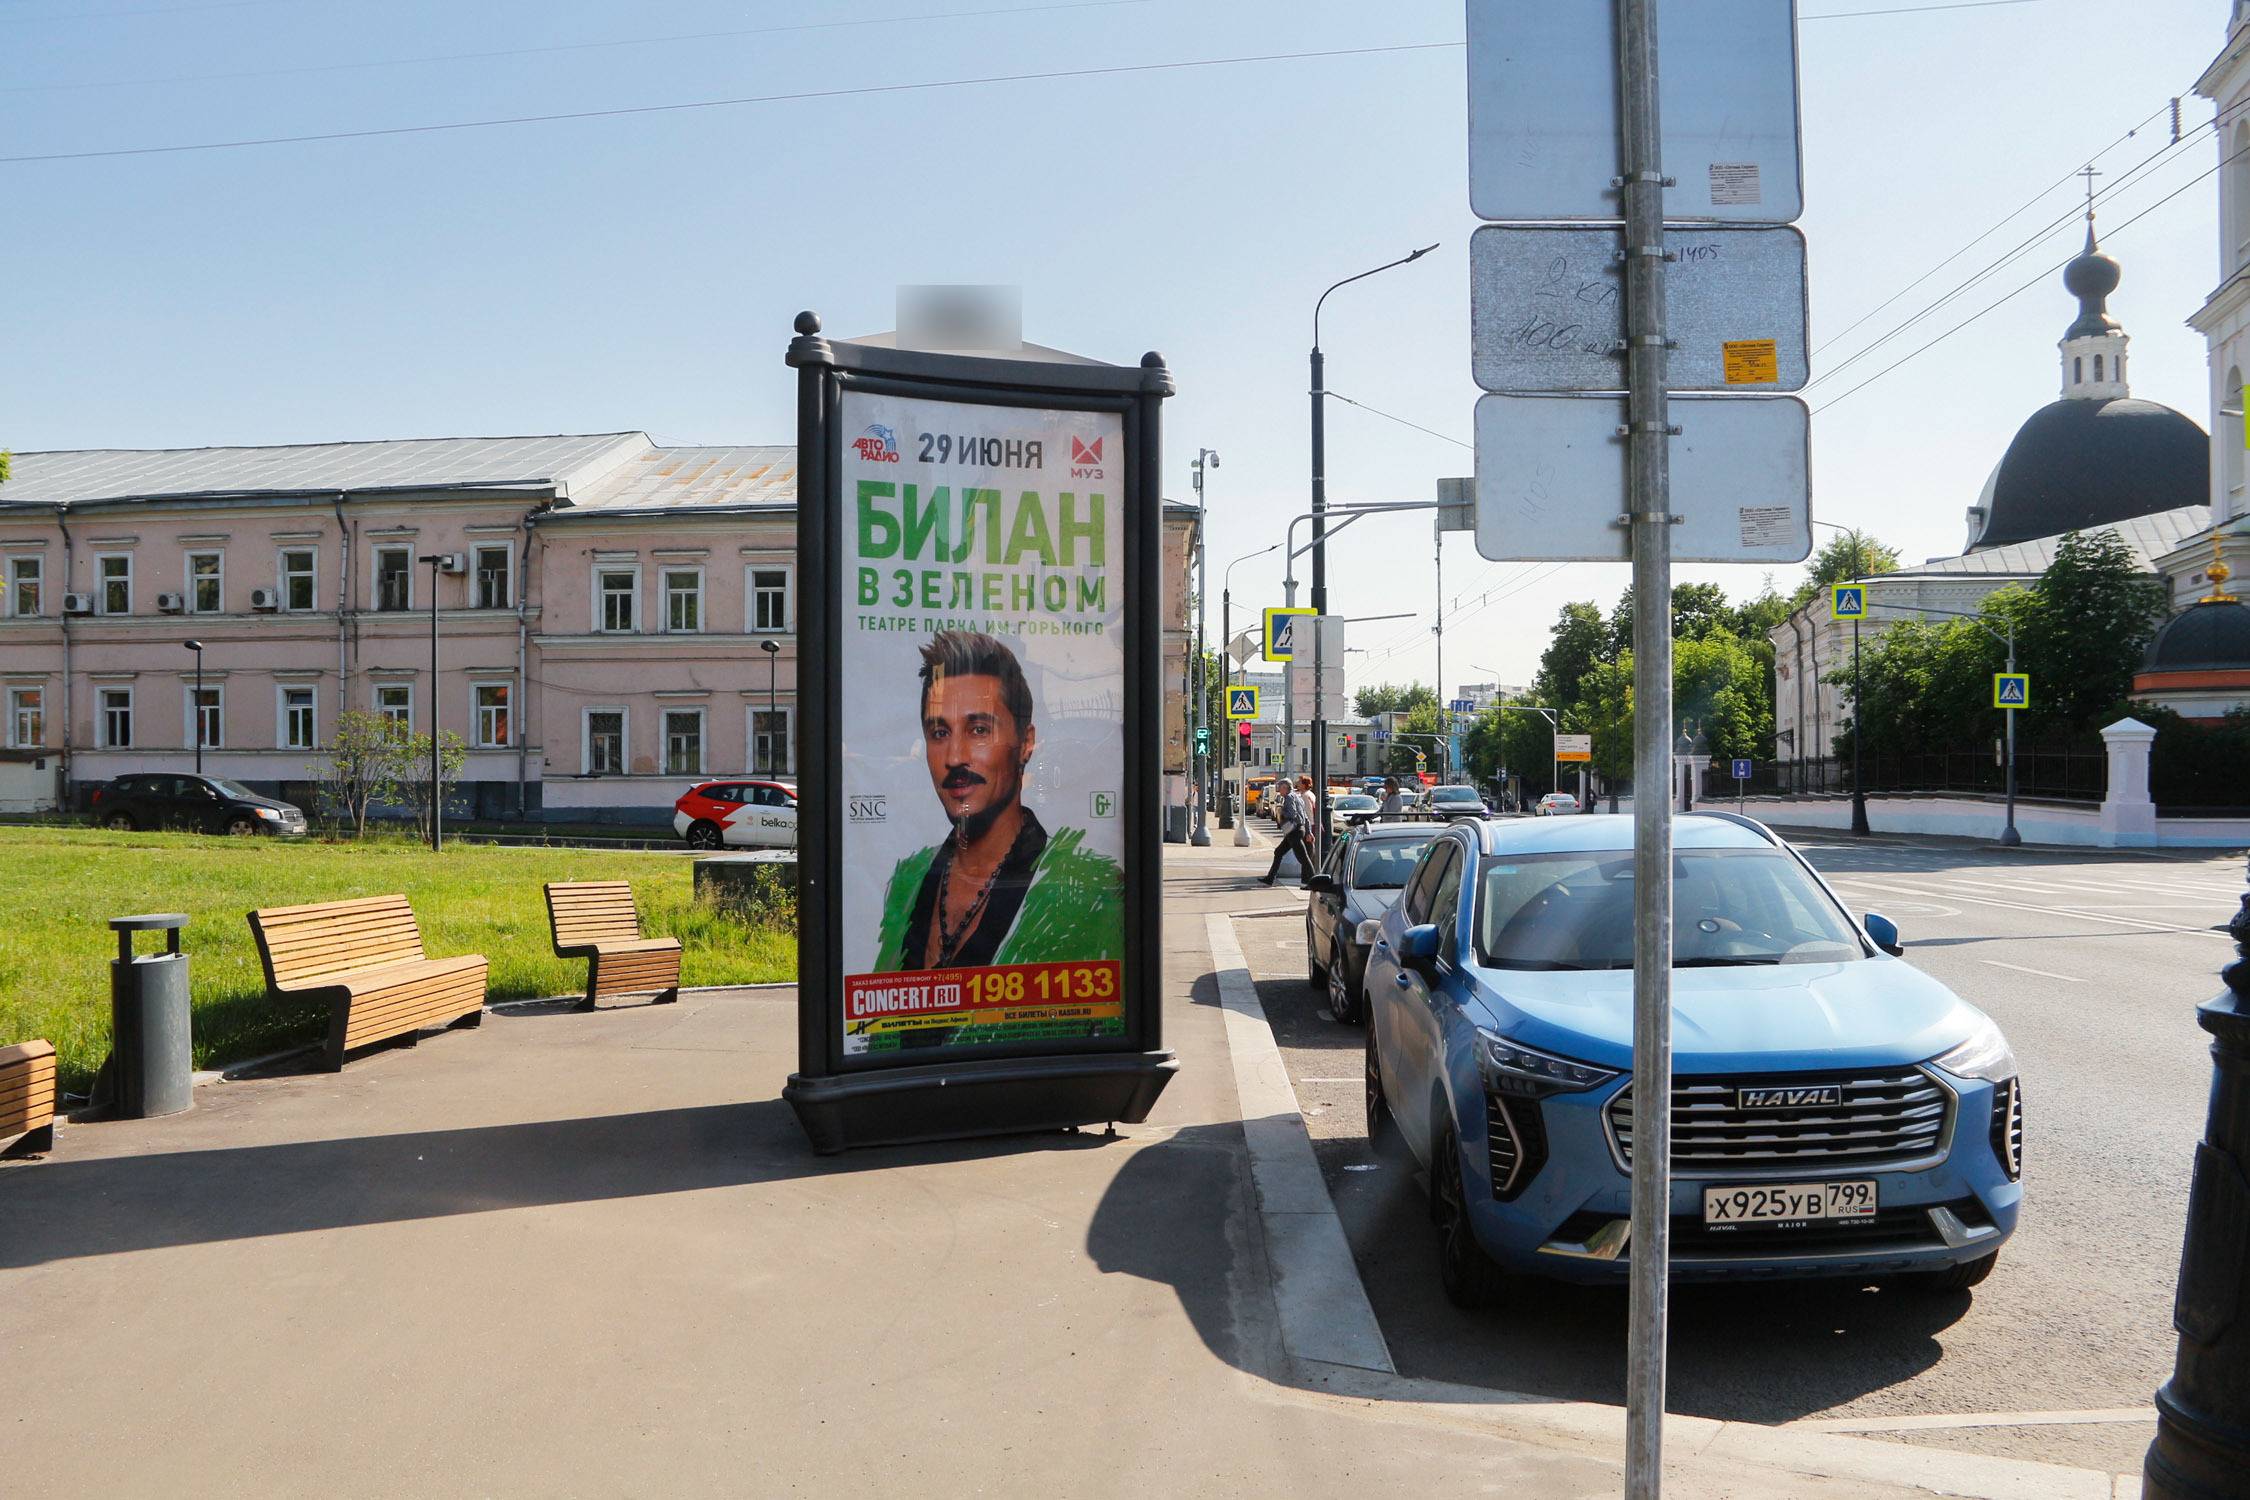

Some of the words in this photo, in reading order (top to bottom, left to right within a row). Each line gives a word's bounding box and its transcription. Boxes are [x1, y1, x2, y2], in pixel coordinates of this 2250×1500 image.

[851, 438, 884, 450] АВТО
[918, 432, 952, 464] 29
[959, 436, 1043, 469] ИЮНЯ
[861, 449, 900, 463] РАДИО
[1070, 467, 1104, 480] МУЗ
[857, 480, 1105, 567] БИЛАН
[858, 566, 880, 606] В
[892, 569, 1105, 612] ЗЕЛЕНОМ
[858, 615, 917, 632] ТЕАТРЕ
[924, 617, 977, 634] ПАРКА
[850, 801, 887, 817] SNC
[1095, 794, 1111, 816] 6+
[933, 973, 962, 983] +7(495)
[966, 972, 1025, 1003] 198
[1034, 967, 1114, 1000] 1133
[853, 984, 960, 1015] CONCERT.RU
[1004, 1012, 1017, 1020] ВСЕ
[1018, 1010, 1047, 1020] БИЛЕТЫ
[882, 1019, 922, 1029] БИЛЕТЫ
[1745, 1089, 1836, 1106] HAVAL
[1828, 1184, 1869, 1206] 799
[1838, 1205, 1858, 1214] RUS
